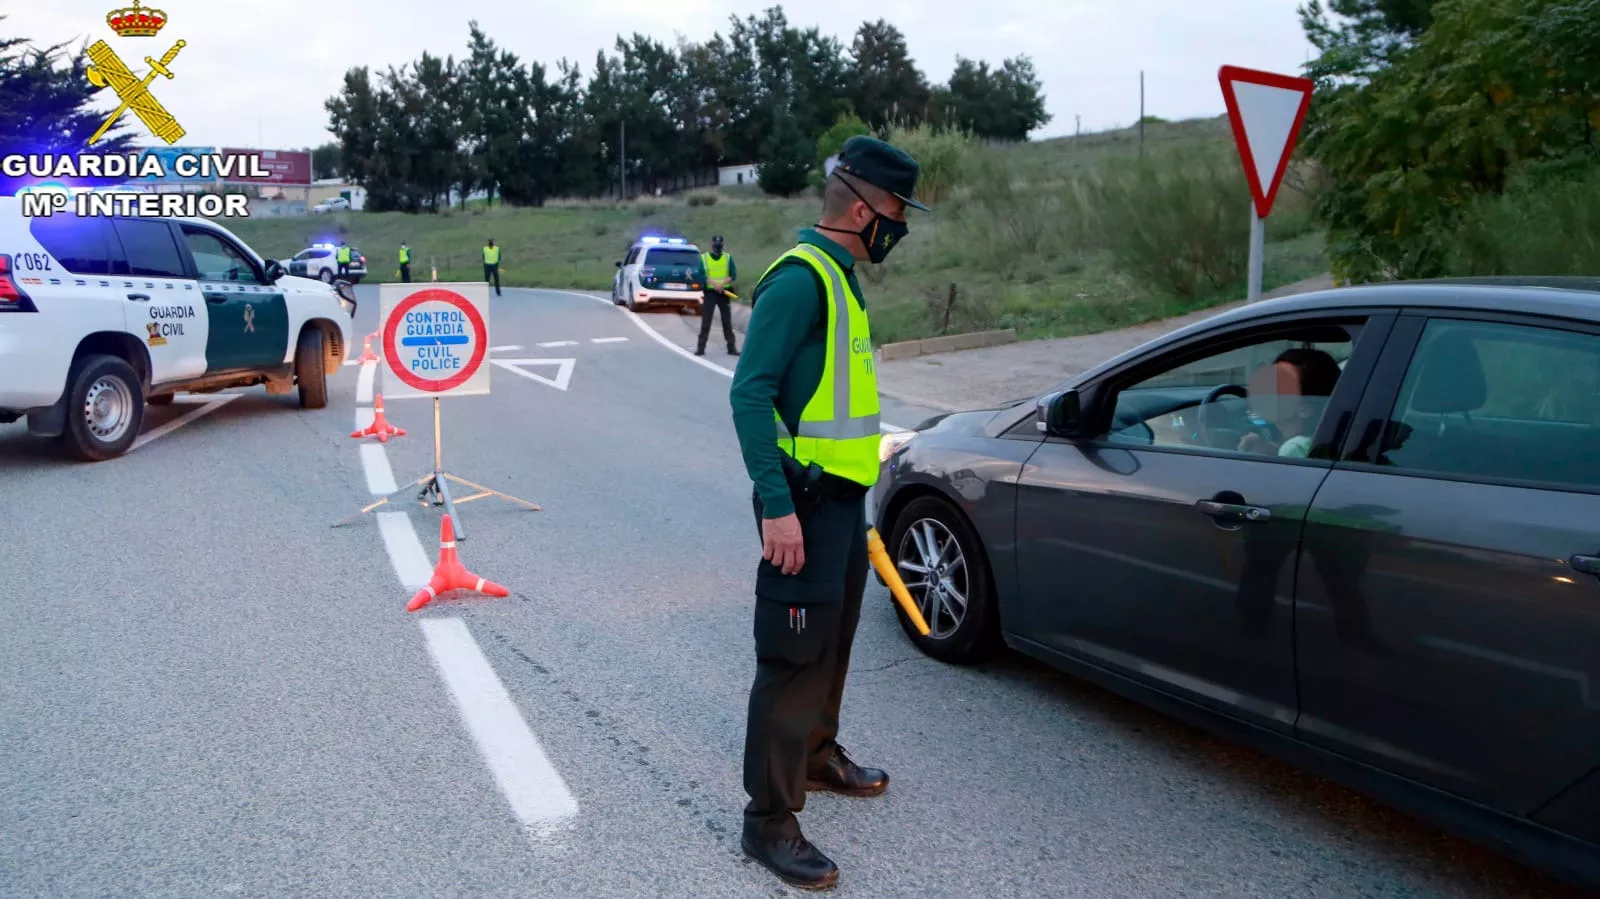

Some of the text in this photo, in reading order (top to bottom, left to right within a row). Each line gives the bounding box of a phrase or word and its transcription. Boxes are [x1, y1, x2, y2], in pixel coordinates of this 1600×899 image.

[24, 253, 51, 270] 062
[149, 305, 195, 319] GUARDIA
[406, 311, 465, 323] CONTROL
[162, 323, 184, 336] CIVIL
[407, 324, 463, 335] GUARDIA
[418, 346, 453, 358] CIVIL
[412, 358, 460, 370] POLICE
